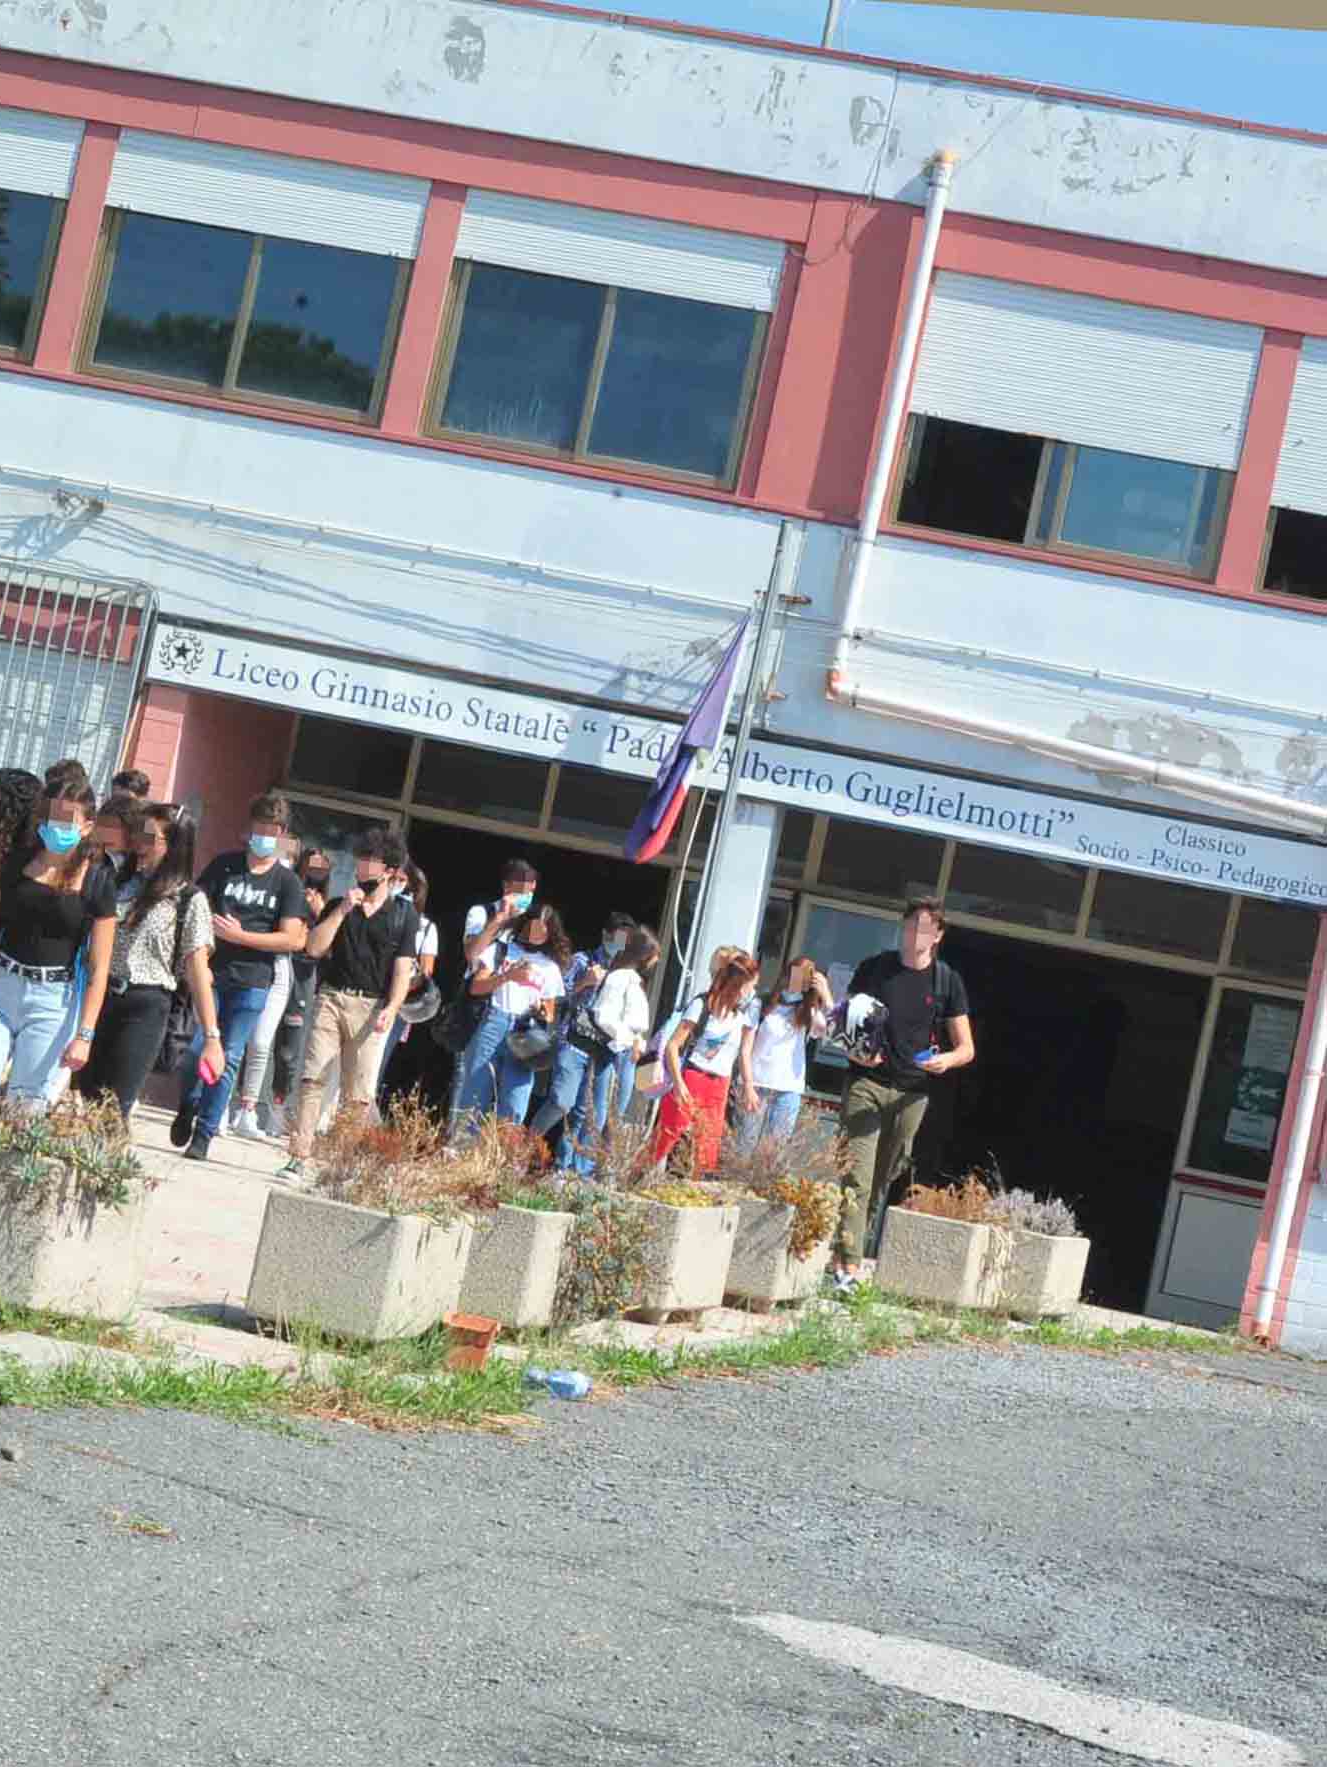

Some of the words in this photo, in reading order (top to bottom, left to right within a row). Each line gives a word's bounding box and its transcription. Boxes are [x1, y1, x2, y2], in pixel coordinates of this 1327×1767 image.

[210, 647, 300, 693] Liceo
[310, 668, 453, 722] Ginnasio
[464, 697, 570, 745] Statale
[712, 746, 834, 796] Alberto
[1165, 823, 1247, 857] Classico
